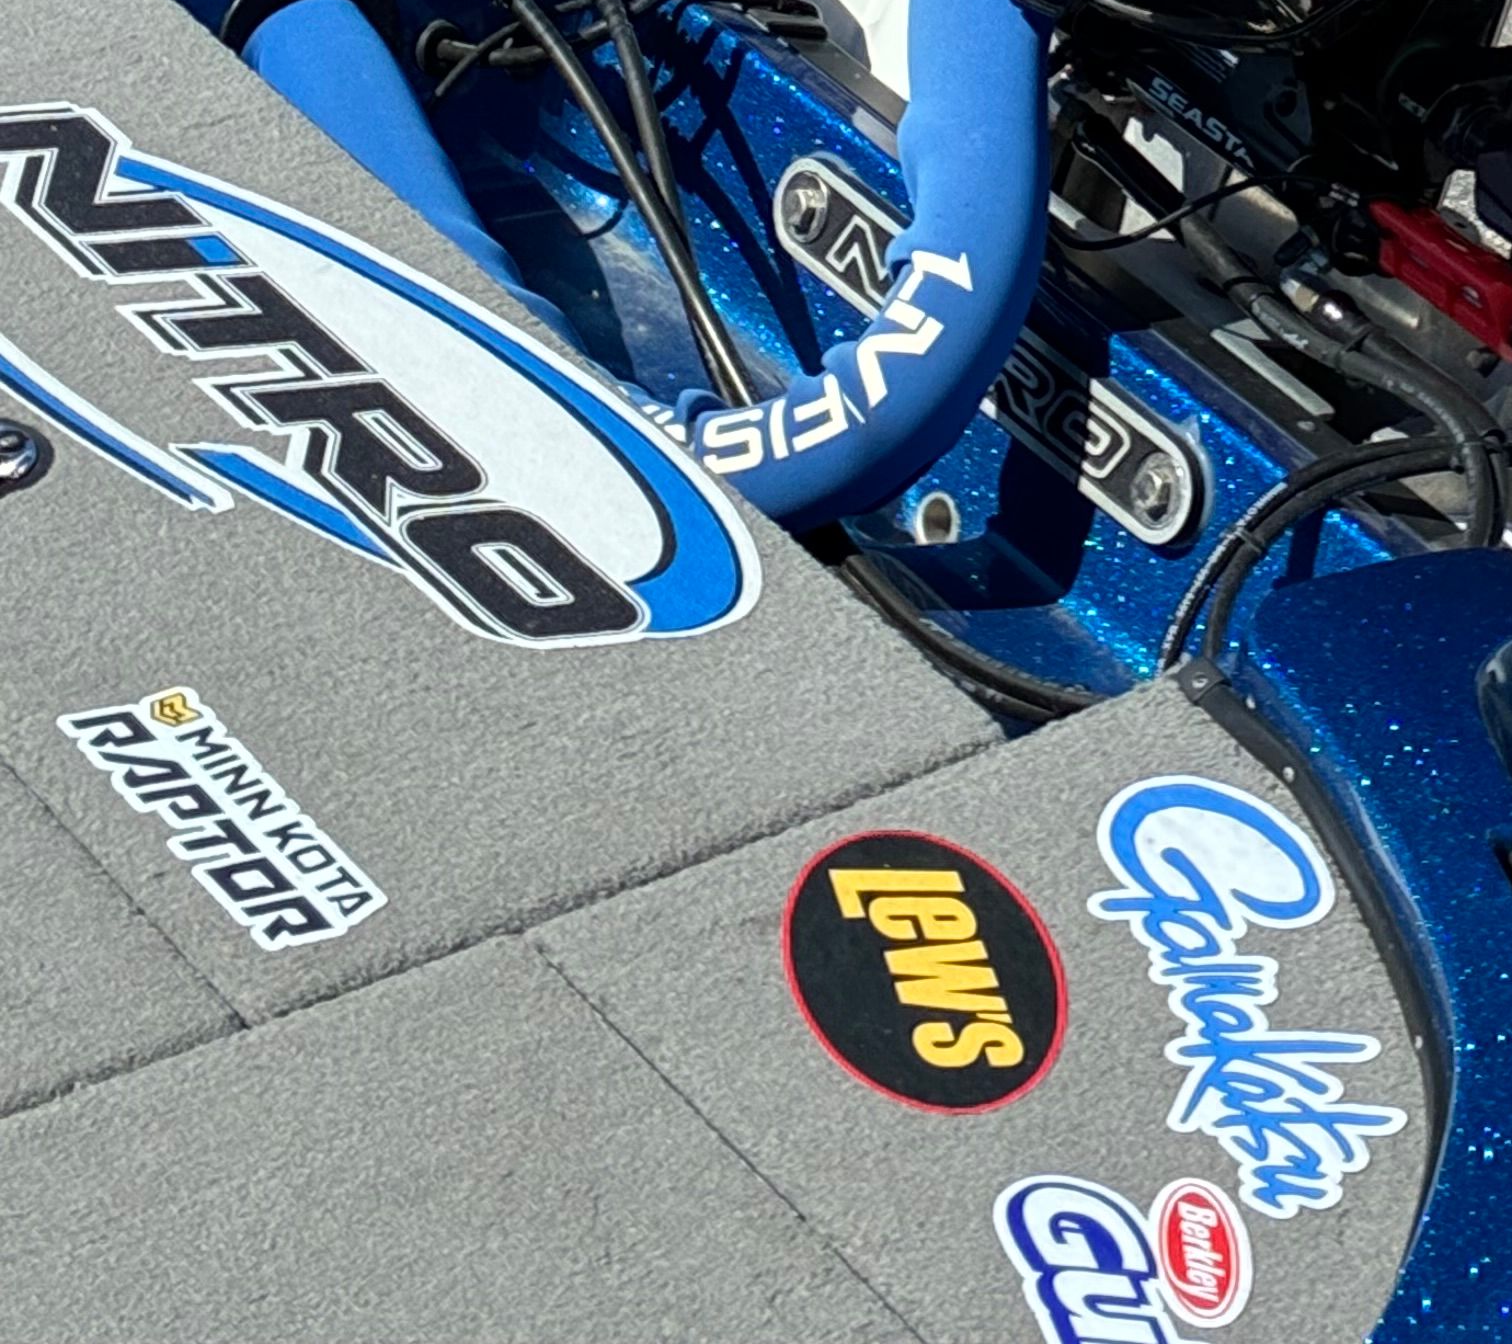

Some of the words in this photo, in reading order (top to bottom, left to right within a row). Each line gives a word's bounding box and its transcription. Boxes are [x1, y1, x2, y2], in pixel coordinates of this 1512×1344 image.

[68, 711, 335, 941] RAPTOR
[175, 725, 287, 822] MINN
[265, 820, 375, 918] KOTA
[1100, 782, 1402, 1209] Gamakatsu
[1177, 1200, 1227, 1305] Berkley
